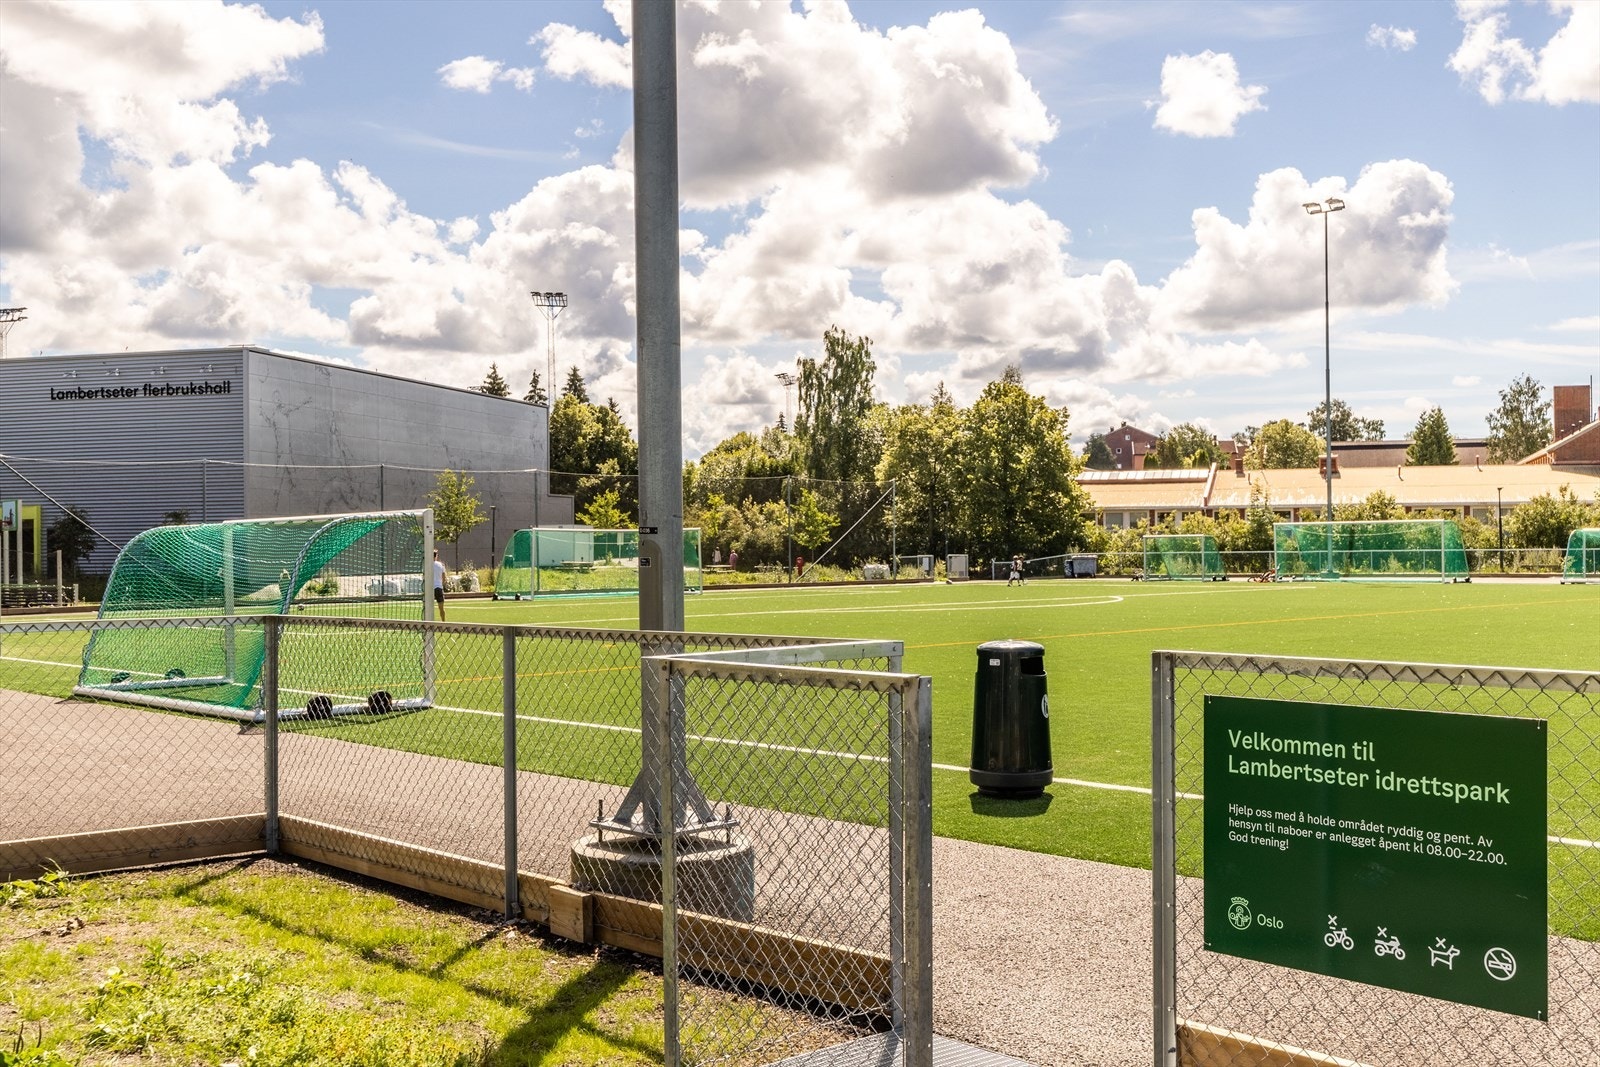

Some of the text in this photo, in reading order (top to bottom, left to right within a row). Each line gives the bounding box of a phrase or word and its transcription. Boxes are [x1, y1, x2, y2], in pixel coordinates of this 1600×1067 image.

[51, 381, 231, 400] Lambertseter flerbrukshall
[1229, 730, 1375, 761] Velkommen til
[1229, 755, 1509, 803] Lambertseter idrettspark
[1229, 804, 1492, 847] Hjelp oss med å holde området ryddig og pent. Av
[1229, 817, 1262, 832] hensyn
[1265, 823, 1275, 832] til
[1278, 826, 1313, 837] naboer
[1330, 833, 1375, 847] anlegget
[1379, 837, 1410, 851] åpent
[1414, 842, 1423, 853] kl
[1229, 831, 1288, 850] God trening!
[1257, 914, 1284, 929] Oslo
